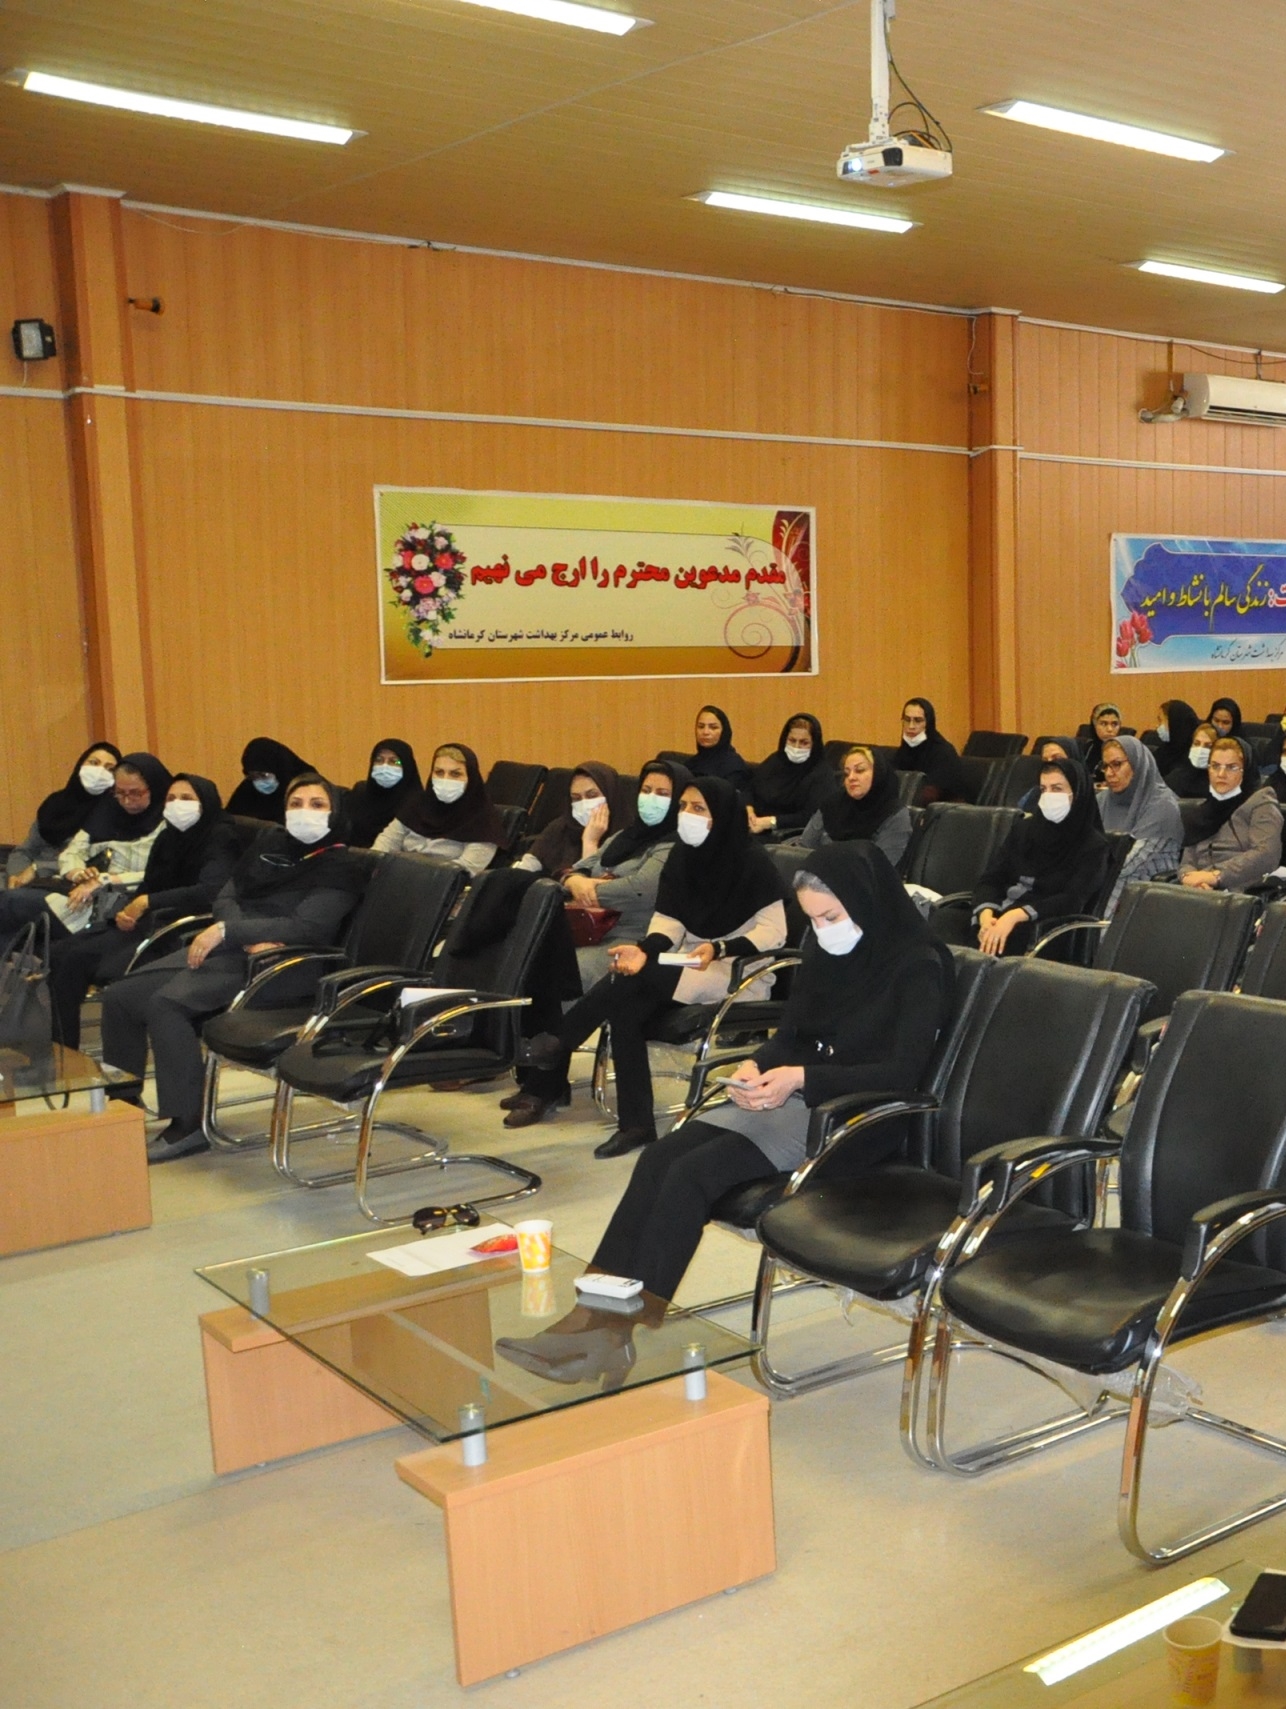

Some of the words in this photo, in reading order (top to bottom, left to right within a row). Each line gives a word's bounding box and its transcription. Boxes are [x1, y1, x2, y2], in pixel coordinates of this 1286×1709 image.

[470, 553, 511, 586] نهیم
[515, 564, 547, 587] می
[551, 555, 587, 588] ارج
[590, 555, 609, 588] را
[613, 561, 671, 589] محترم
[674, 565, 741, 590] مدعوین
[745, 562, 786, 591] مقدم
[1167, 591, 1176, 606] و
[1236, 563, 1268, 614] زندگی
[1140, 587, 1166, 618] امید
[448, 629, 485, 642] کرمانشاه
[487, 629, 523, 642] شهرستان
[526, 629, 557, 642] بهداشت
[559, 629, 579, 642] مرکز
[581, 630, 608, 642] عمومی
[611, 629, 634, 642] روابط
